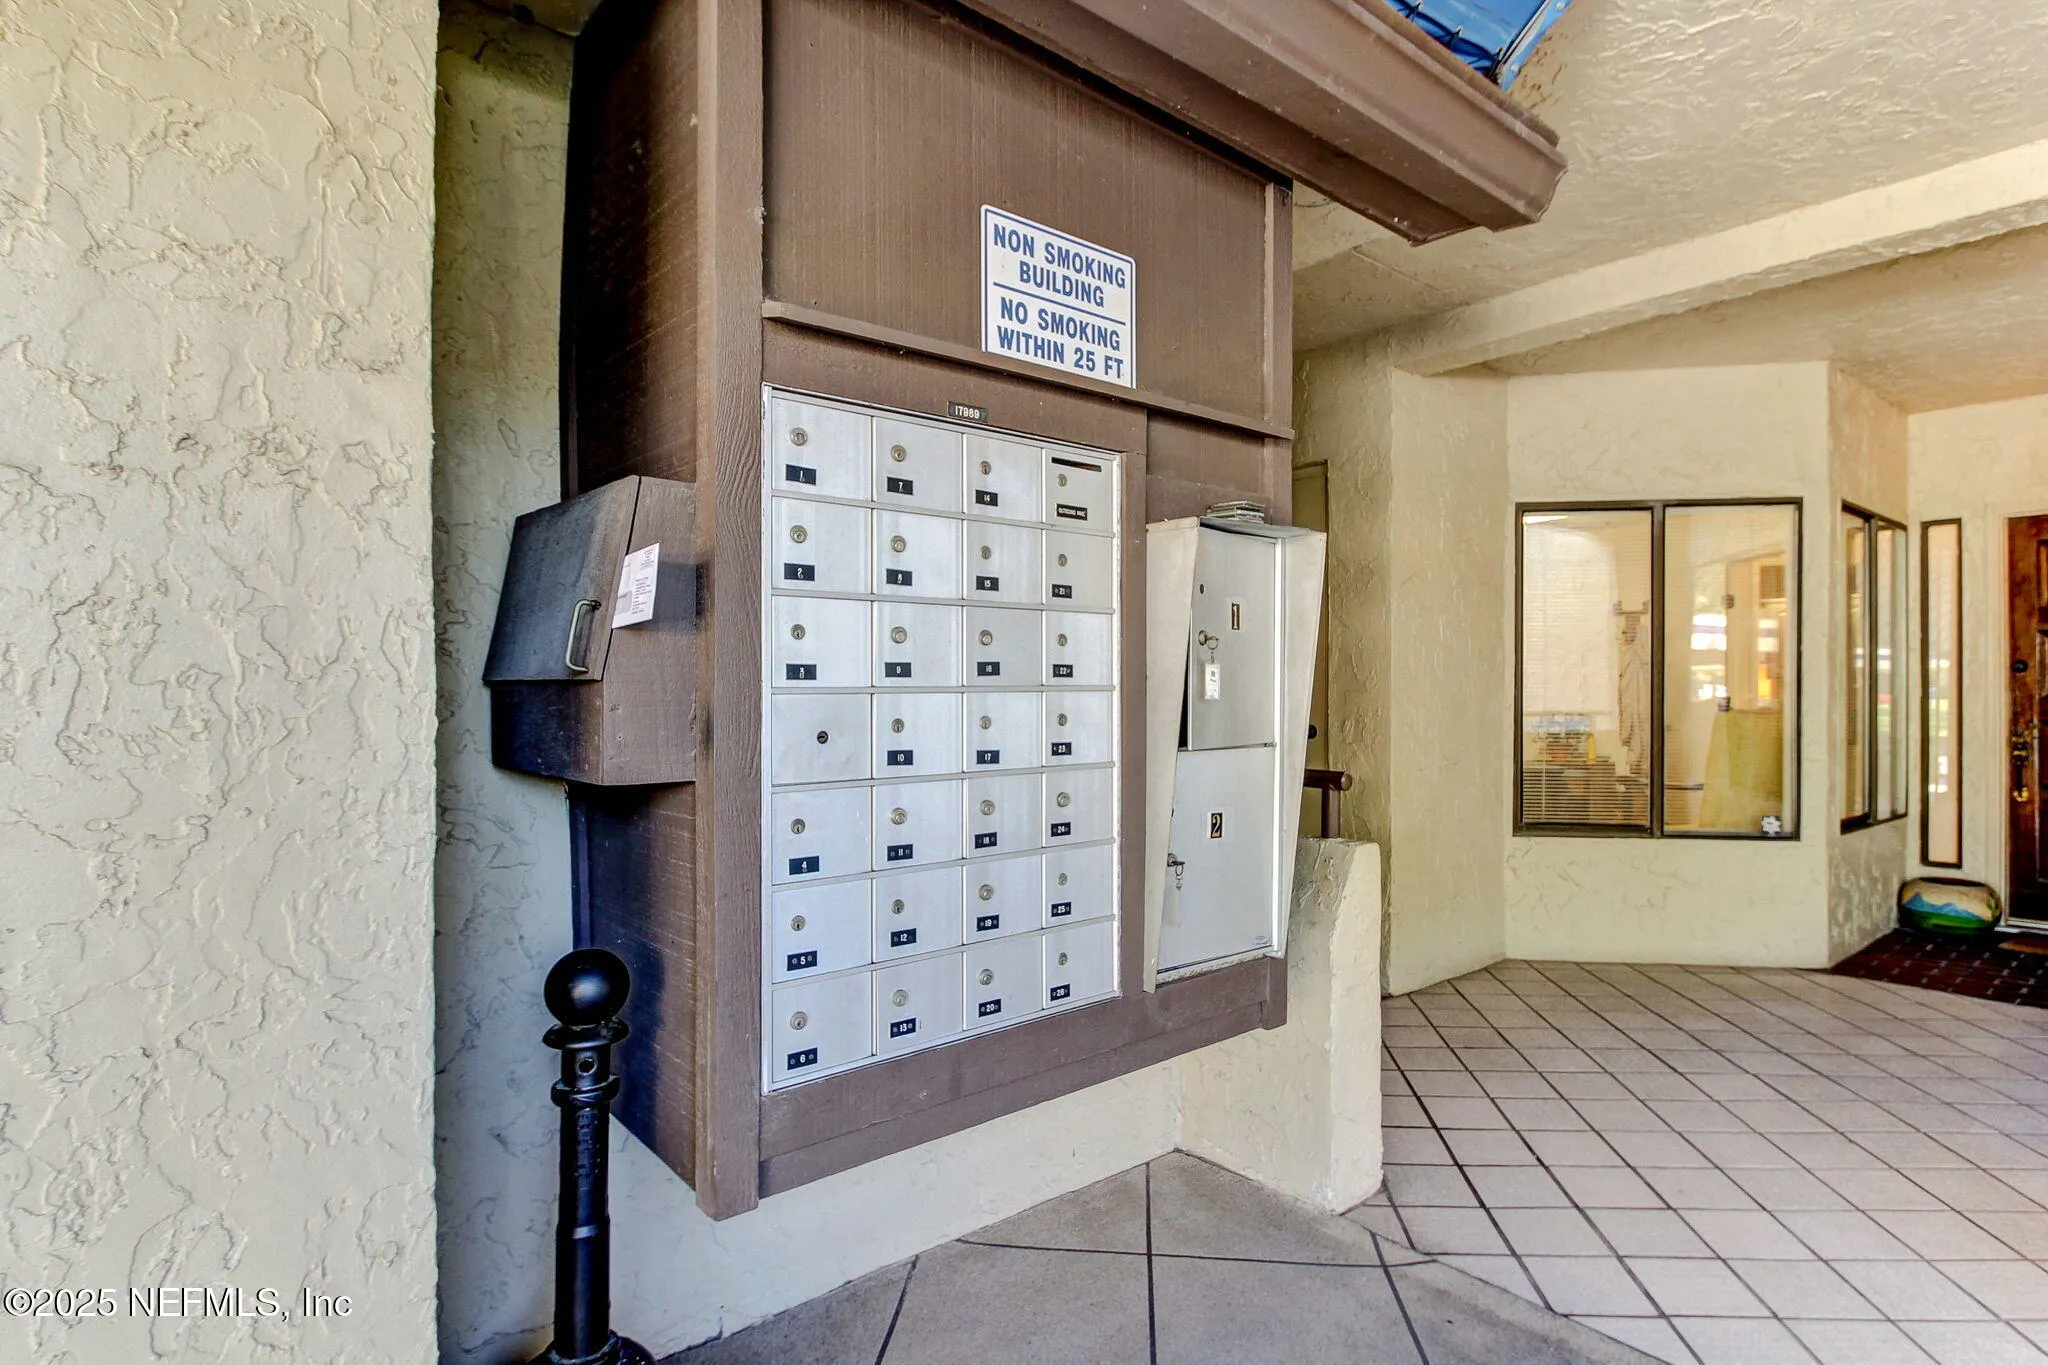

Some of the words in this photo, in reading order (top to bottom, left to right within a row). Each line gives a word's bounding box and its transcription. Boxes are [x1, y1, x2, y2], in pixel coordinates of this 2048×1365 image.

[993, 223, 1035, 258] NON
[1044, 242, 1126, 289] SMOKING
[1019, 260, 1104, 308] BUILDING
[1000, 296, 1028, 325] NO
[1038, 308, 1121, 351] SMOKING
[997, 325, 1065, 364] WITHIN
[1074, 347, 1096, 372] 25
[1104, 355, 1124, 379] FT
[1210, 814, 1220, 837] 2
